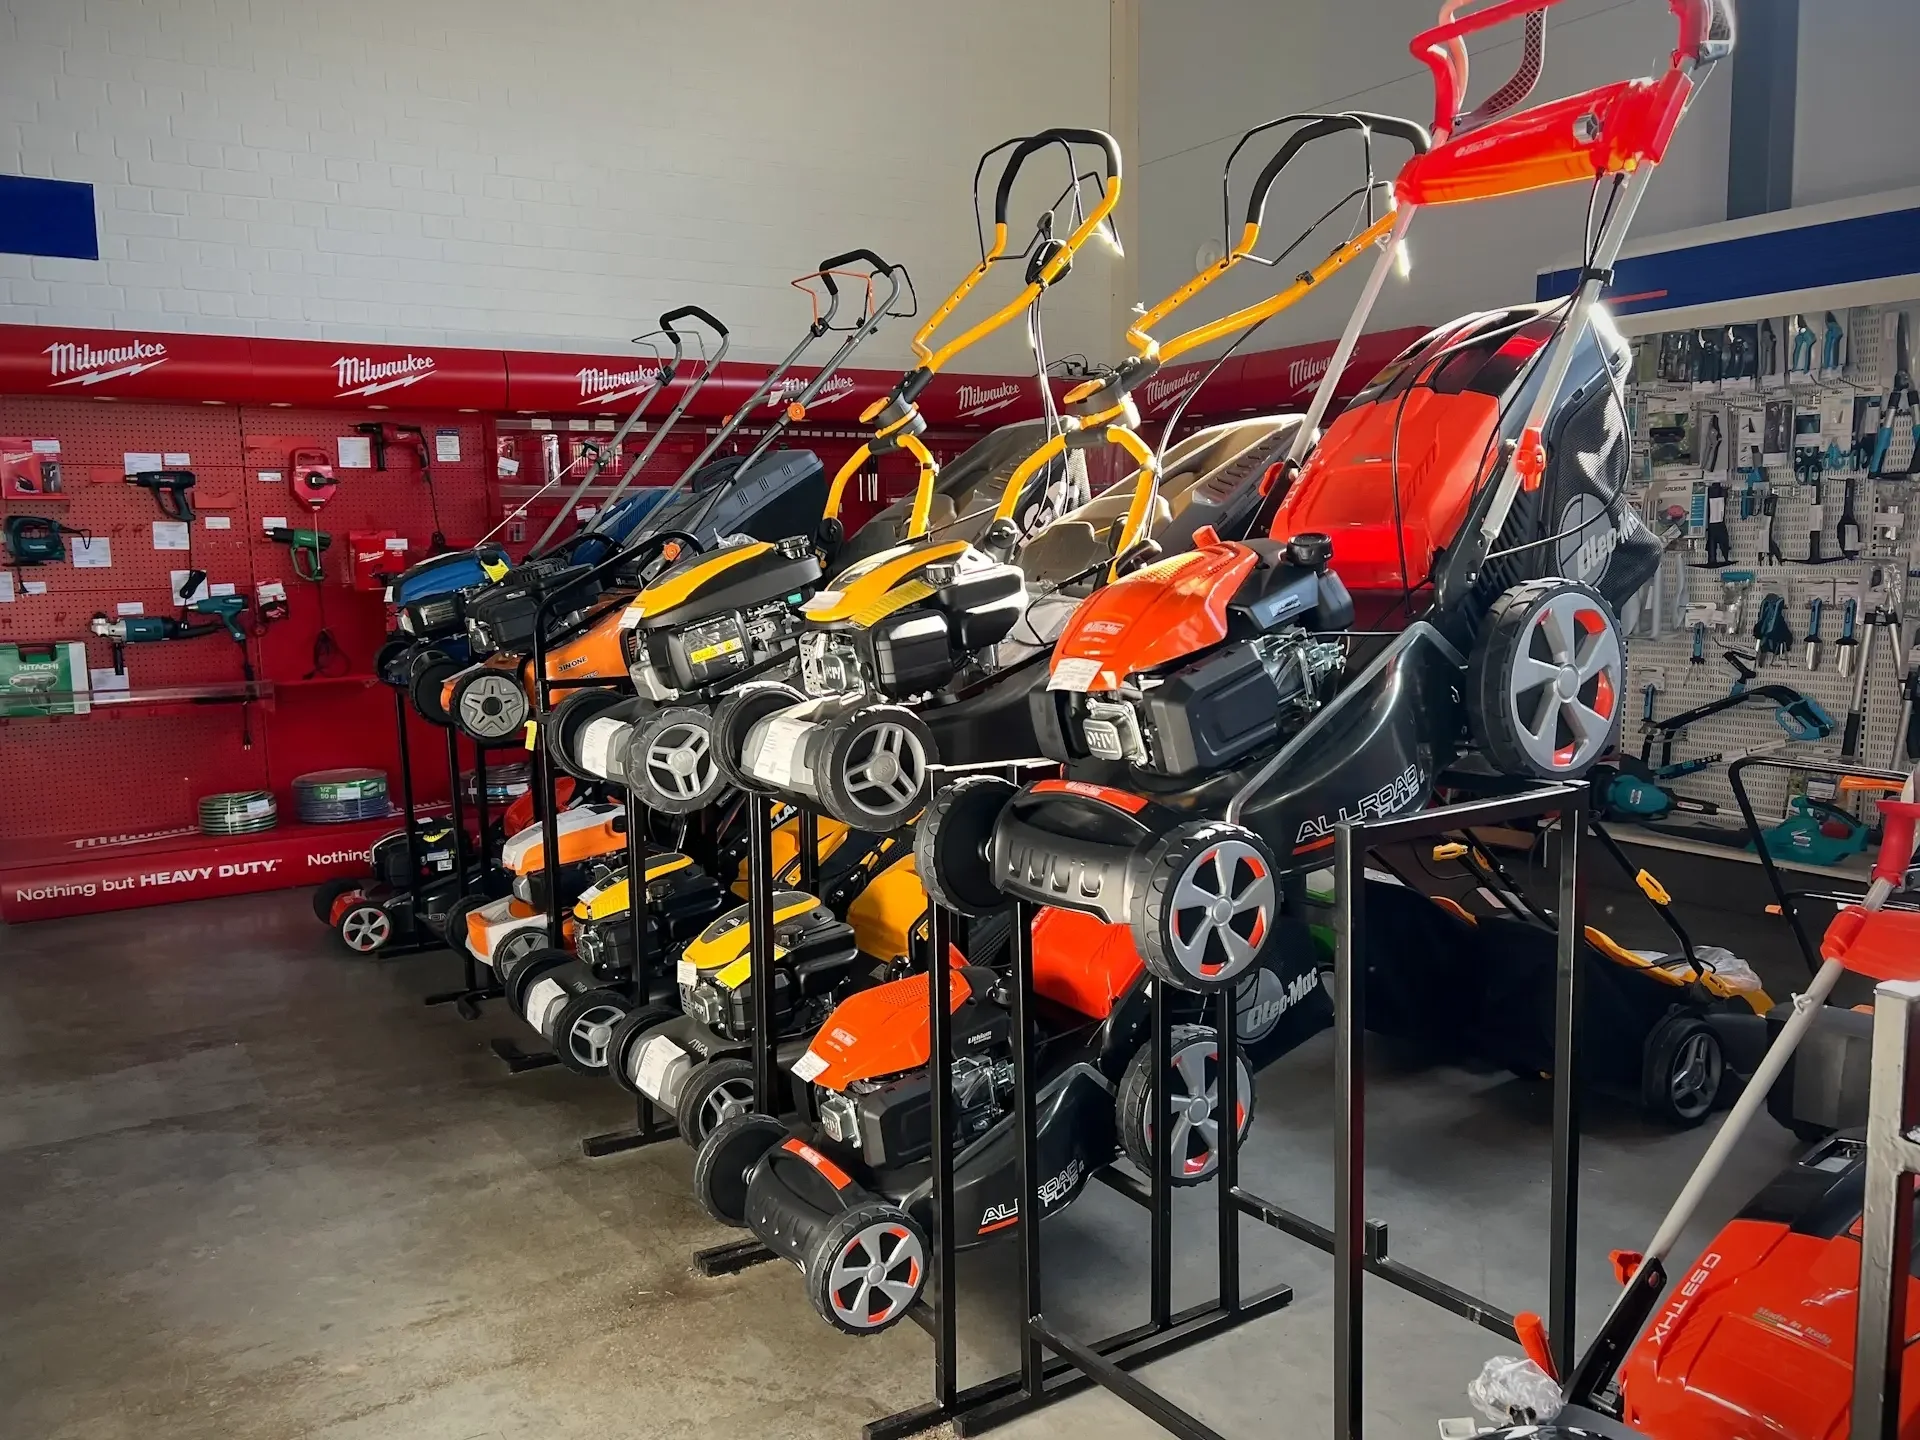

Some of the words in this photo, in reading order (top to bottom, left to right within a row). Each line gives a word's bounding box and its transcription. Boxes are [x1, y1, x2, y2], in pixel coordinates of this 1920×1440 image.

[41, 339, 167, 377] Milwaukee
[331, 354, 435, 388] Milwaukee
[956, 382, 1020, 410] Milwaukee
[1144, 370, 1200, 405] Milwaukee
[18, 663, 59, 671] HITACHI
[1295, 763, 1419, 844] ALLROAD
[1378, 785, 1420, 819] PLUS
[307, 847, 373, 867] Nothing
[16, 881, 97, 902] Nothing
[102, 876, 135, 893] but
[140, 866, 215, 888] HEAVY
[1246, 967, 1318, 1033] Oleo-Mac
[1647, 1298, 1689, 1346] THX
